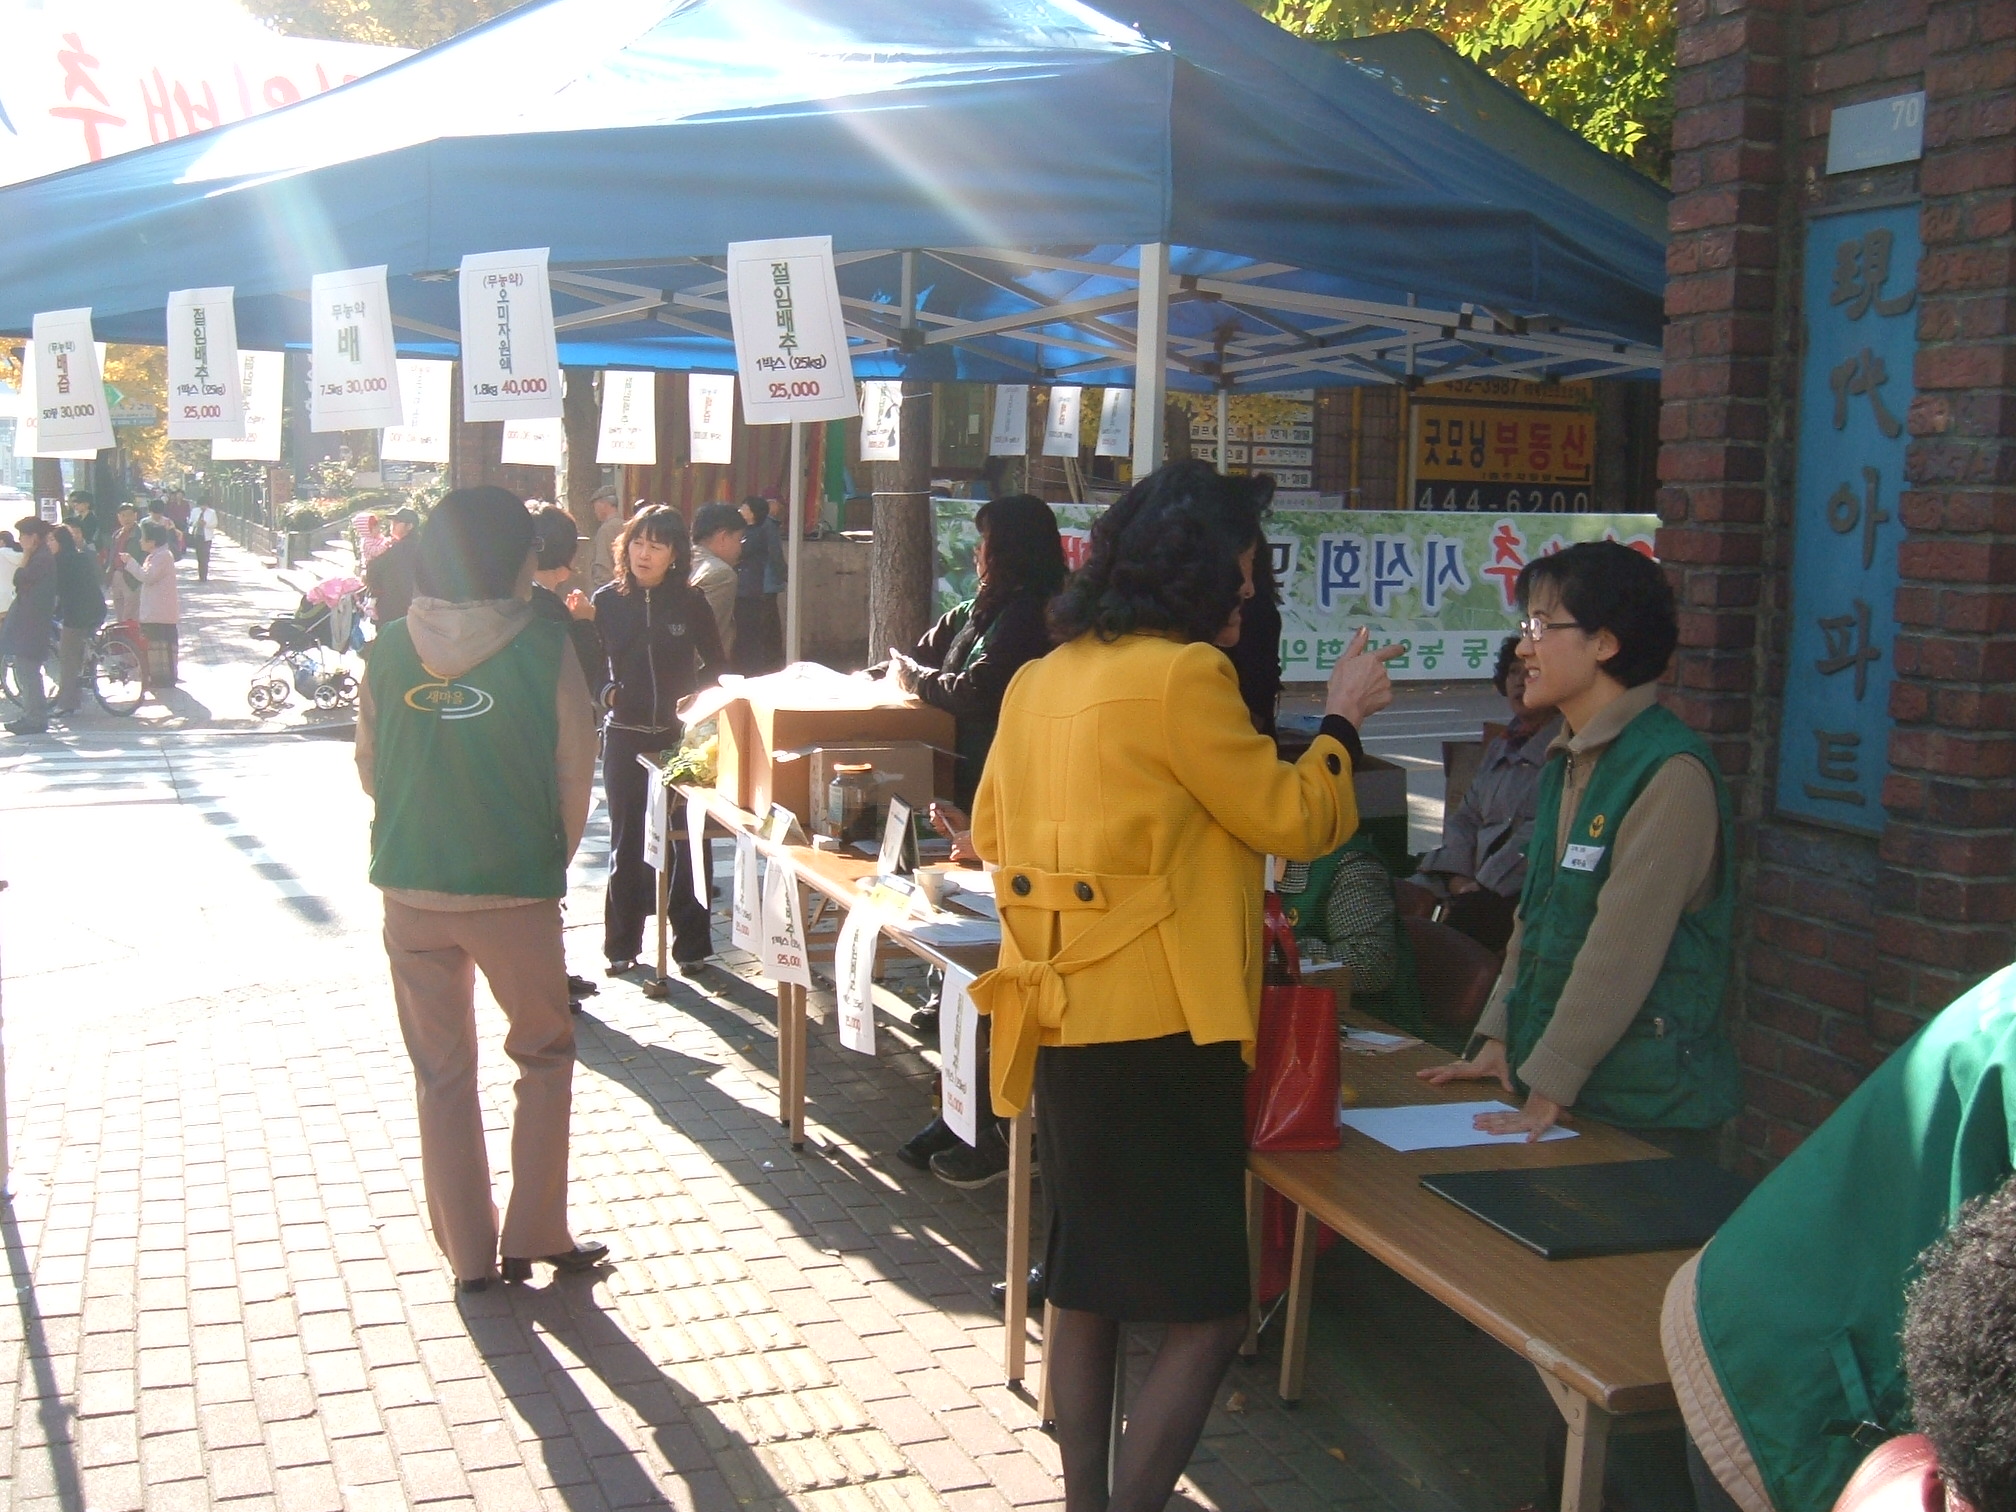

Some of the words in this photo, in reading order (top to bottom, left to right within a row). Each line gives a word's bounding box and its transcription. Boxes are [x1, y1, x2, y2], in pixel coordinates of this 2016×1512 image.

[1892, 97, 1920, 131] 70
[482, 272, 524, 289] (무농약)
[331, 301, 366, 320] 무농약
[771, 261, 798, 356] 절임배추
[497, 288, 513, 374] 오미자원액
[193, 308, 209, 386] 절임배추
[337, 325, 361, 363] 배
[756, 355, 786, 372] 1박스
[789, 354, 827, 370] (25kg)
[177, 383, 199, 396] 1박스
[320, 384, 343, 396] 7.5kg
[346, 377, 388, 395] 30,000
[473, 383, 499, 397] 1.8kg
[501, 377, 548, 396] 40,000
[769, 380, 820, 399] 25,000
[60, 404, 95, 420] 30,000
[184, 405, 221, 420] 25,000
[1494, 421, 1588, 472] 부동산
[1418, 486, 1589, 513] 444-6200
[1802, 226, 1919, 808] 現代아파트
